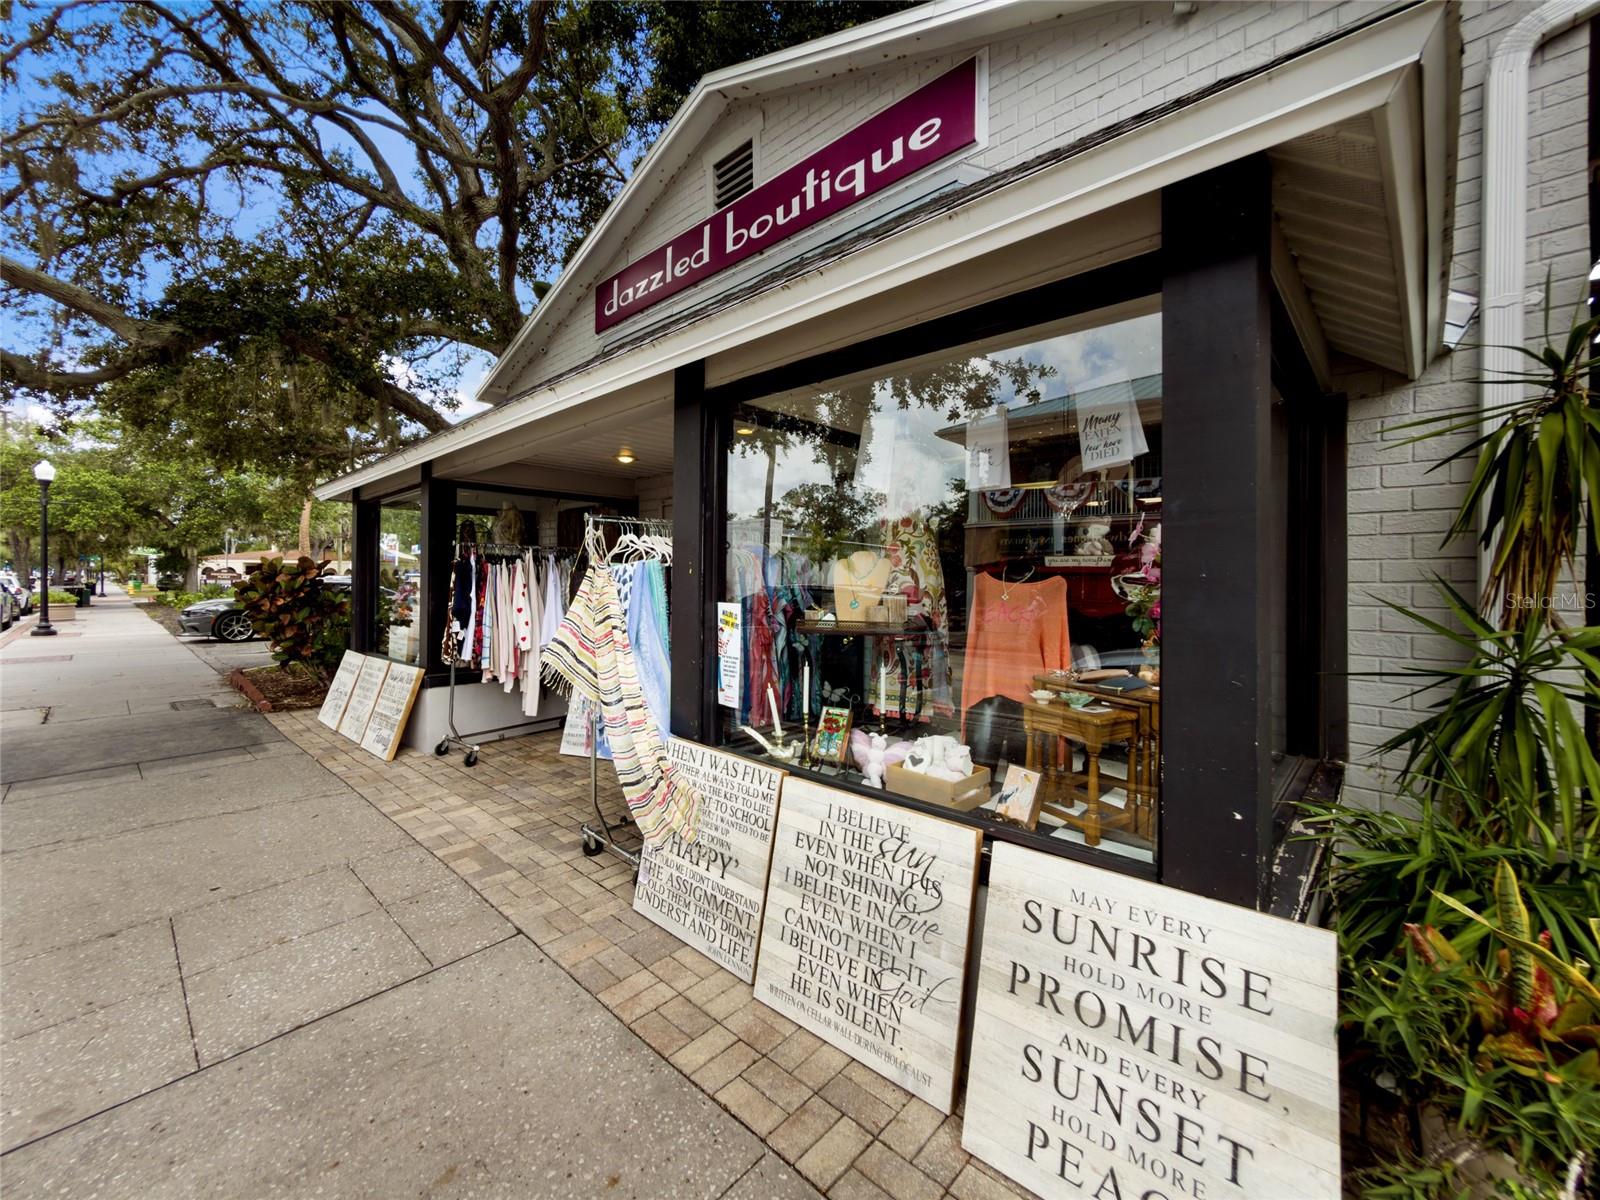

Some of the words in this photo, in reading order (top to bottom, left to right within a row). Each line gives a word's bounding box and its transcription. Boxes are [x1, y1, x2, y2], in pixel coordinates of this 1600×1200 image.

[604, 223, 711, 317] dazzled
[725, 116, 943, 254] boutique
[1082, 412, 1123, 432] Many
[1091, 447, 1120, 461] DIED
[691, 779, 707, 792] WAS
[708, 784, 722, 798] THE
[723, 790, 740, 804] KEY
[741, 796, 753, 809] TO
[700, 751, 705, 767] I
[709, 754, 740, 778] WAS
[742, 765, 778, 791] FIVE
[702, 771, 736, 791] ALWAYS
[737, 782, 759, 799] TOLD
[761, 791, 775, 805] ME
[707, 833, 732, 852] DOWN
[714, 800, 728, 814] TO
[729, 805, 771, 832] SCHOOL
[719, 816, 749, 833] WANTED
[749, 828, 759, 838] TO
[760, 832, 770, 843] BE
[720, 826, 730, 838] UP
[819, 820, 837, 840] IN
[841, 827, 874, 854] THE
[827, 803, 833, 819] I
[837, 806, 911, 844] BELIEVE
[675, 863, 685, 874] ME
[711, 881, 760, 914] UNDERSTAND
[795, 831, 838, 860] EVEN
[843, 847, 895, 882] WHEN
[900, 869, 919, 890] IT
[923, 877, 942, 900] IS
[804, 854, 839, 881] NOT
[642, 857, 663, 881] THE
[666, 872, 756, 934] ASSIGNMENT.
[646, 878, 665, 896] OLD
[667, 888, 691, 911] THEM
[694, 903, 719, 926] THEY
[784, 867, 790, 882] I
[794, 870, 862, 914] BELIEVE
[866, 898, 886, 923] IN
[1069, 888, 1119, 914] MAY
[1127, 903, 1213, 945] EVERY
[636, 885, 717, 944] UNDERSTAND
[719, 934, 752, 969] LIFE.
[784, 907, 853, 951] CANNOT
[857, 940, 901, 977] FEEL
[800, 894, 844, 927] EVEN
[850, 914, 905, 954] WHEN
[910, 941, 916, 960] I
[780, 926, 786, 942] I
[789, 931, 859, 979] BELIEVE
[863, 965, 883, 990] IN
[1021, 899, 1275, 1017] SUNRISE
[790, 973, 813, 999] HE
[816, 986, 831, 1009] IS
[835, 997, 904, 1051] SILENT.
[797, 954, 842, 992] EVEN
[847, 980, 903, 1025] WHEN
[1063, 955, 1126, 992] HOLD
[1136, 983, 1213, 1026] MORE
[796, 999, 807, 1014] ON
[807, 1004, 832, 1028] CELLAR
[832, 1020, 852, 1041] WALL
[853, 1033, 885, 1058] DURING
[884, 1050, 933, 1088] HOLOCAUST
[1058, 1032, 1109, 1066] AND
[1118, 1057, 1208, 1111] EVERY
[1020, 1043, 1255, 1189] SUNSET
[1051, 1105, 1117, 1152] HOLD
[1127, 1143, 1208, 1200] MORE
